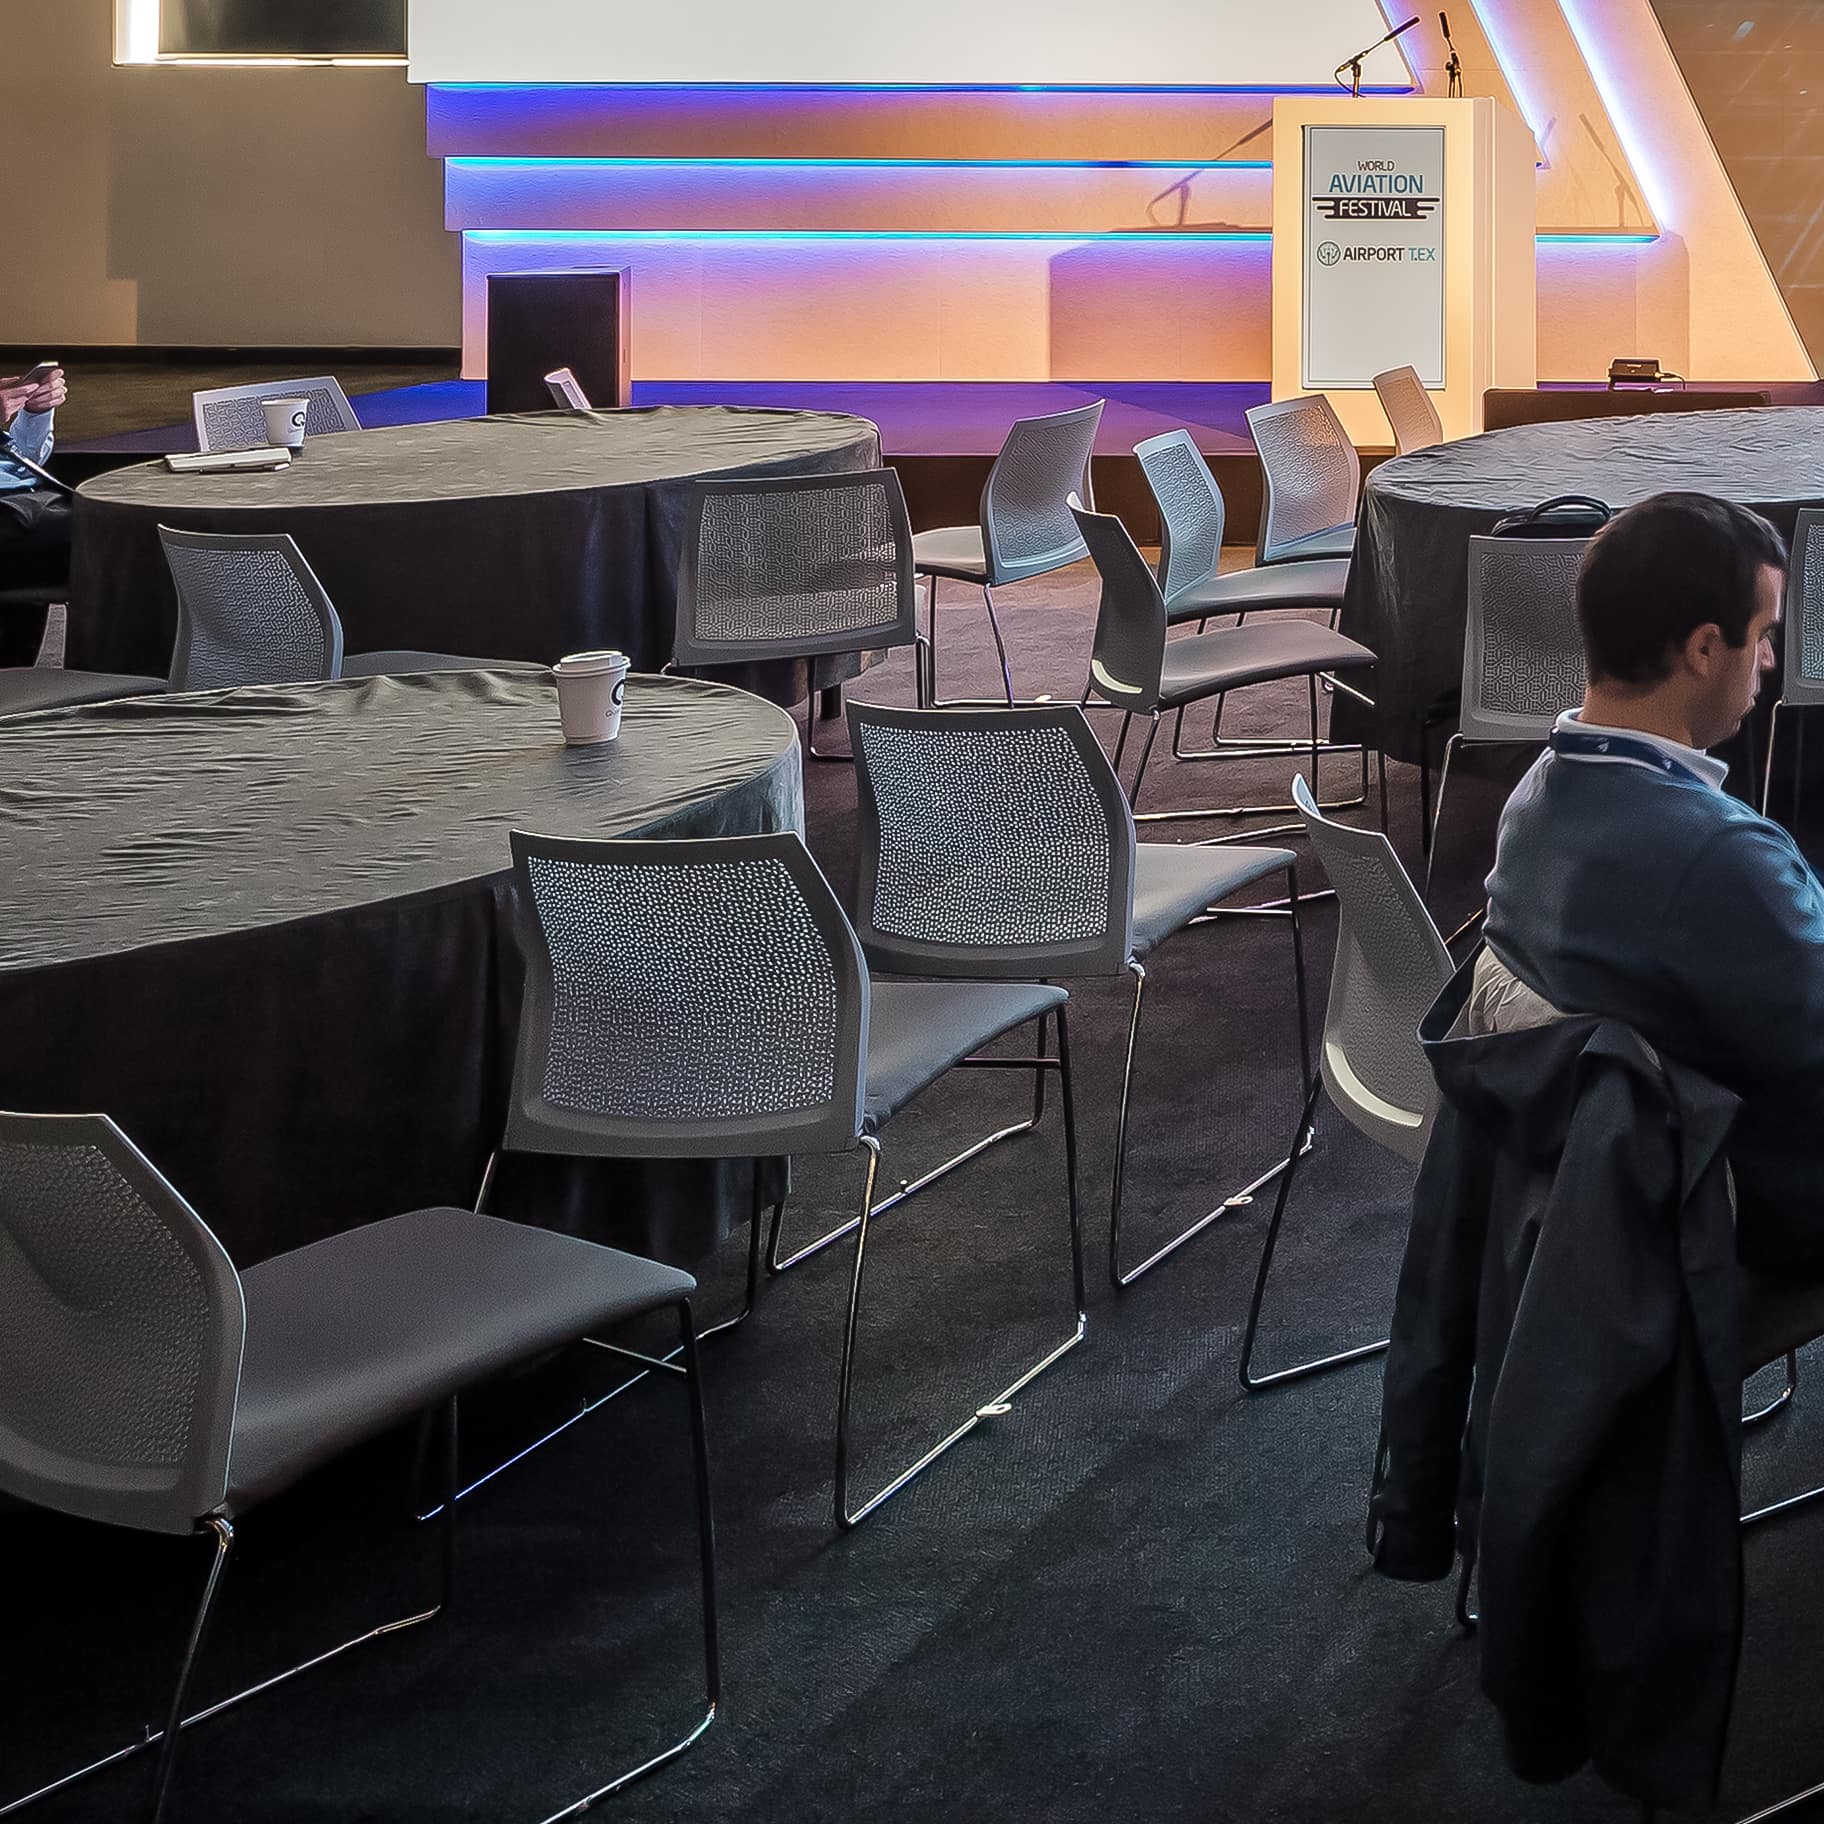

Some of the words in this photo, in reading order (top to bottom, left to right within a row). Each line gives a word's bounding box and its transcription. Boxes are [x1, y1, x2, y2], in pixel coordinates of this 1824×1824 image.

[1358, 160, 1394, 171] WORLD
[1329, 174, 1423, 193] AVIATION
[1339, 201, 1411, 216] FESTIVAL
[1343, 248, 1404, 260] AIRPORT
